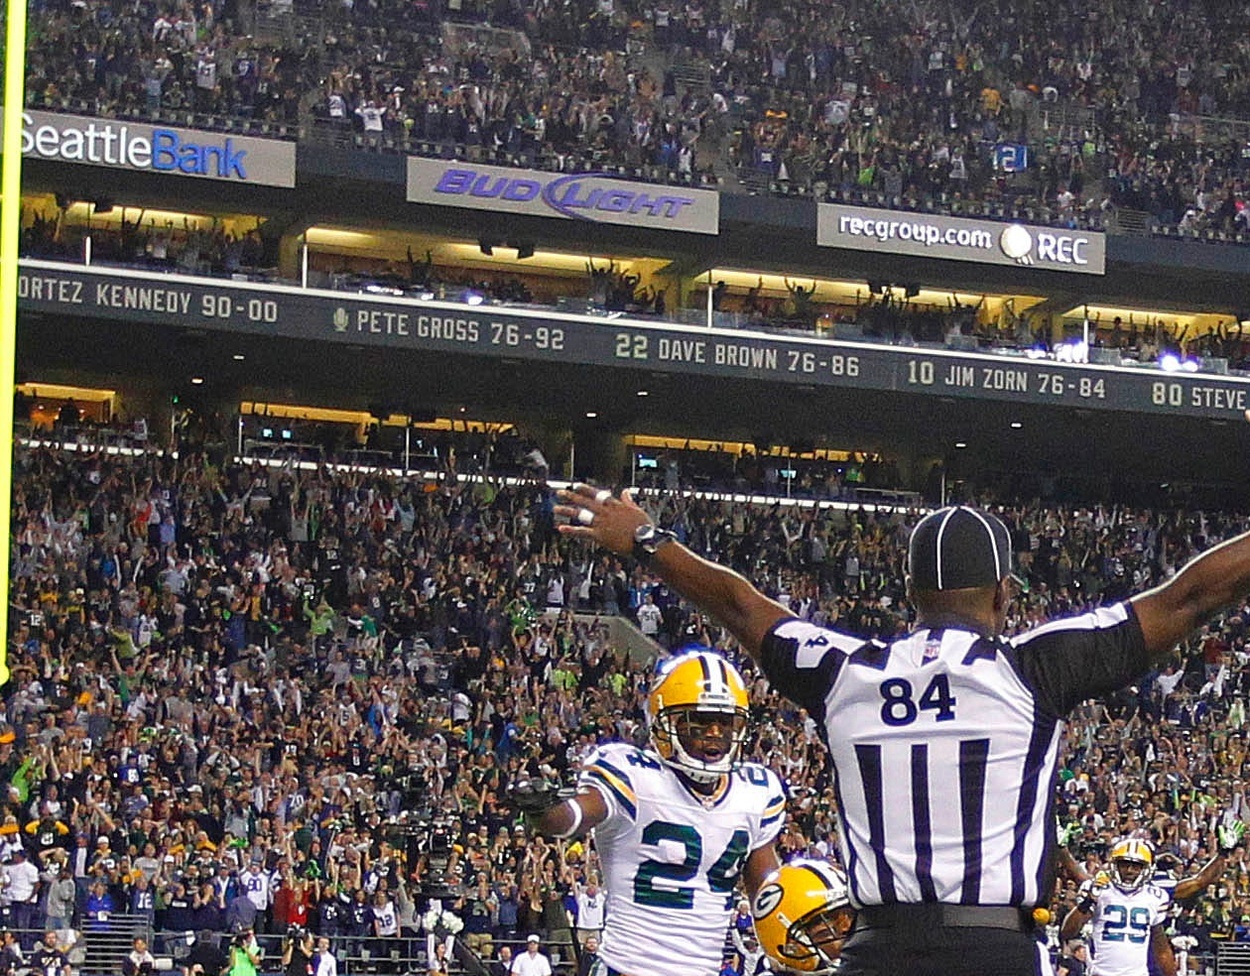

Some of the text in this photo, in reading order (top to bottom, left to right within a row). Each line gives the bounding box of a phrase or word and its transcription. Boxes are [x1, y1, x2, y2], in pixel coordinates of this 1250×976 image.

[434, 169, 695, 218] BUD LIGHT
[839, 215, 1088, 264] recgroup.com REC
[18, 276, 278, 322] ORTEZ KENNEDY 90-00
[357, 310, 565, 350] PETE GROSS 76-92
[615, 333, 859, 376] 22 DAVE BROWN 76-86
[907, 360, 1106, 398] 10 JIM ZORN 76-84
[1152, 382, 1182, 406] 80
[1191, 387, 1246, 411] STEVE
[879, 673, 957, 727] 84
[633, 820, 751, 910] 24
[1102, 904, 1151, 944] 29
